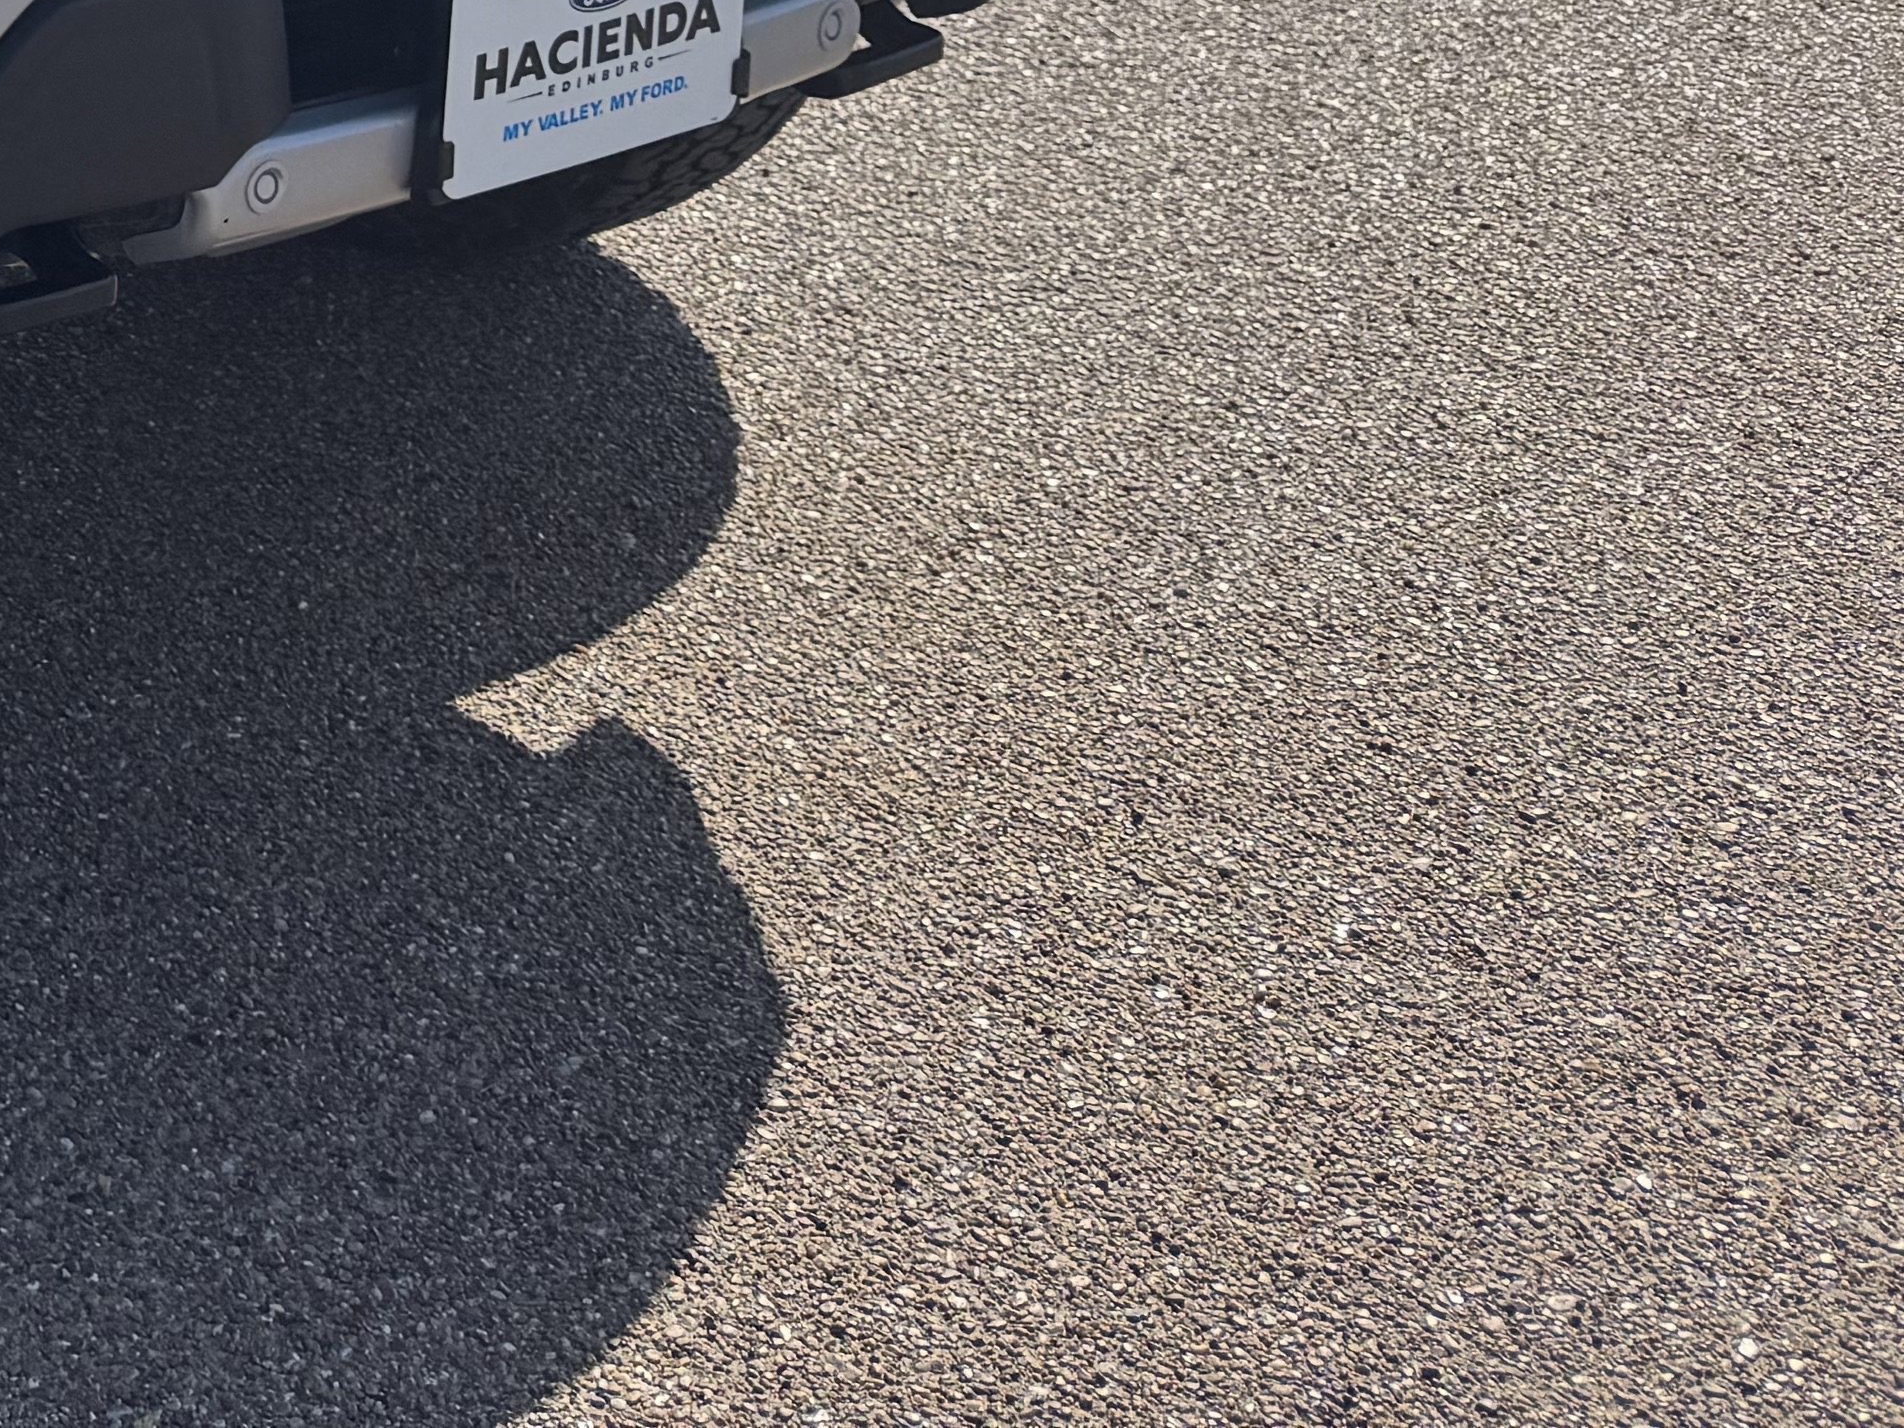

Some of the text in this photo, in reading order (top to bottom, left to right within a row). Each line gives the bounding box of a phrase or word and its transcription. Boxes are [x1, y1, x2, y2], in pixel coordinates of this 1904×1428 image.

[547, 56, 655, 97] EDINBURG
[502, 75, 689, 142] MY VALLEY. MY FORD.
